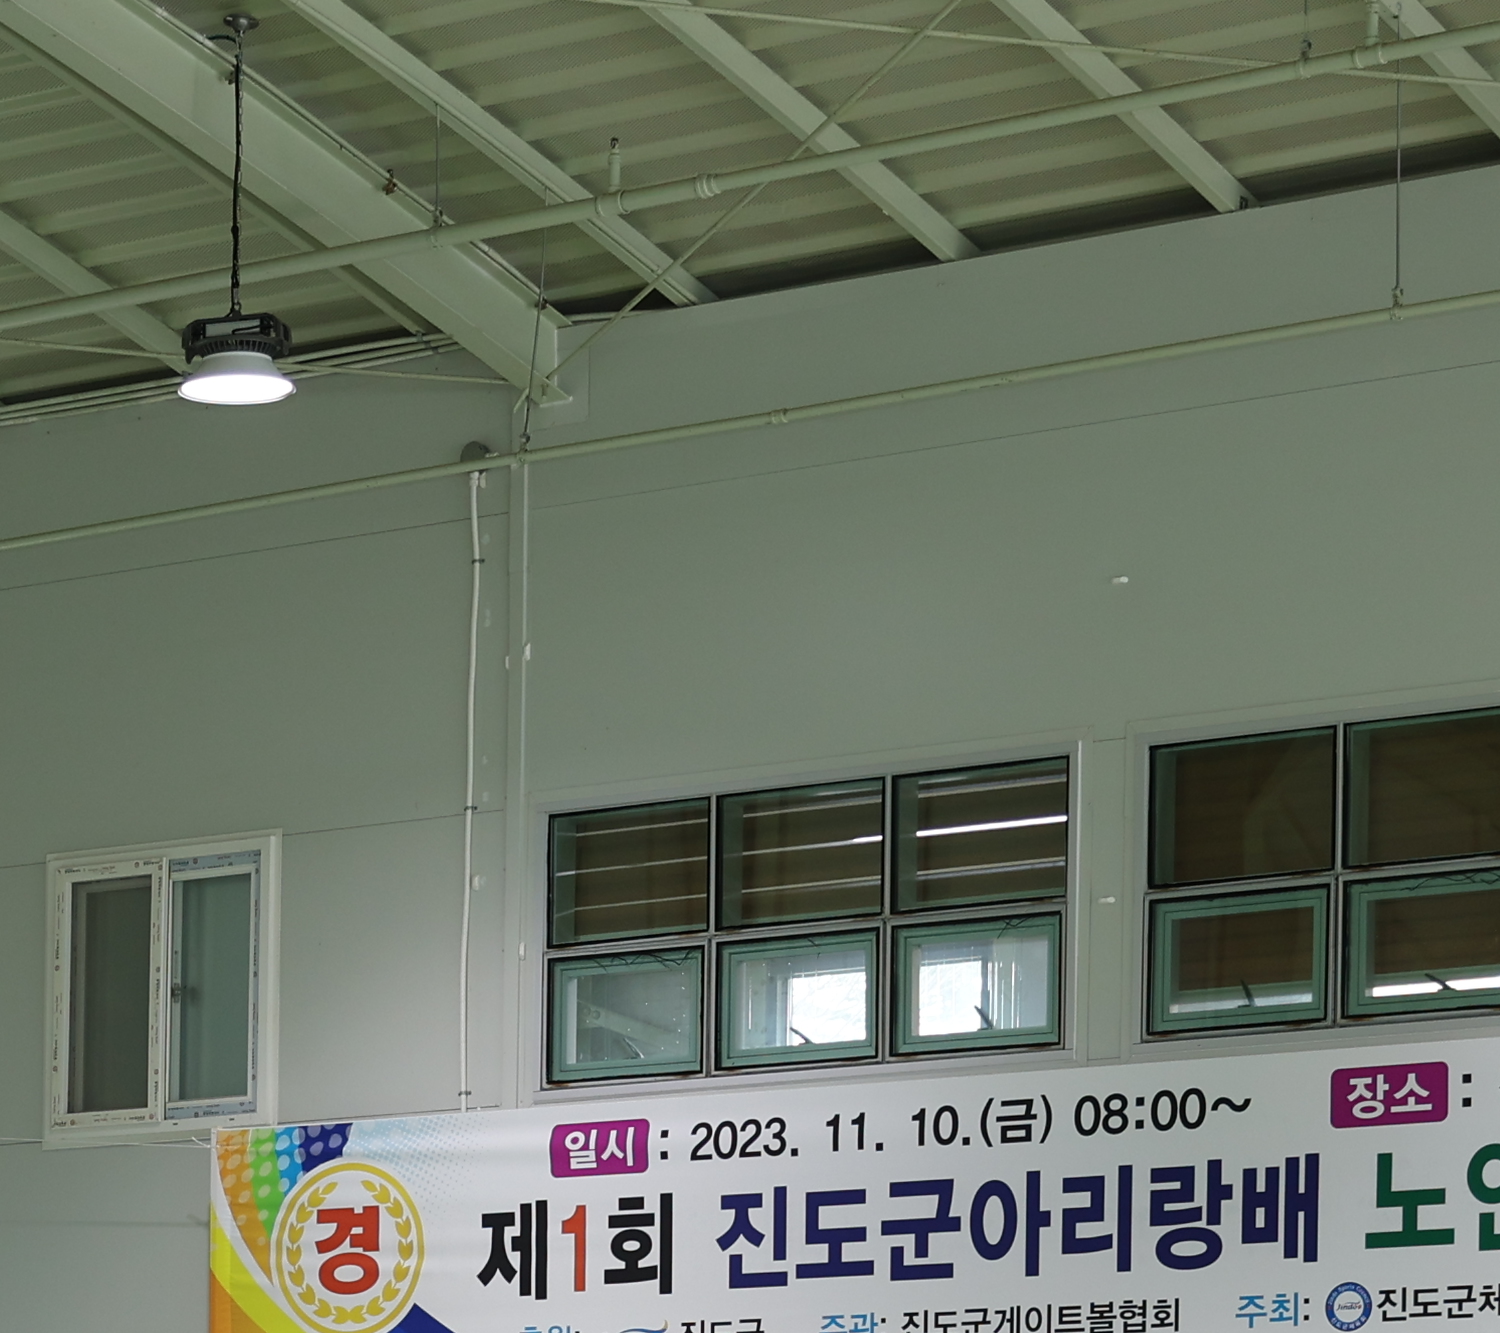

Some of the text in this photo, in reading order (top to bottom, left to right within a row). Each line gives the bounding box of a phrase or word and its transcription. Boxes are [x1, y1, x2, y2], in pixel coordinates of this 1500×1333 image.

[565, 1127, 634, 1169] 일시
[691, 1118, 798, 1160] 2023.
[826, 1113, 883, 1151] 11.
[1075, 1088, 1251, 1136] 08:00~
[1347, 1073, 1432, 1118] 장소
[316, 1206, 379, 1296] 경
[477, 1193, 672, 1300] 제1회
[717, 1153, 1319, 1288] 진도군아리랑배
[1236, 1293, 1309, 1328] 주최:
